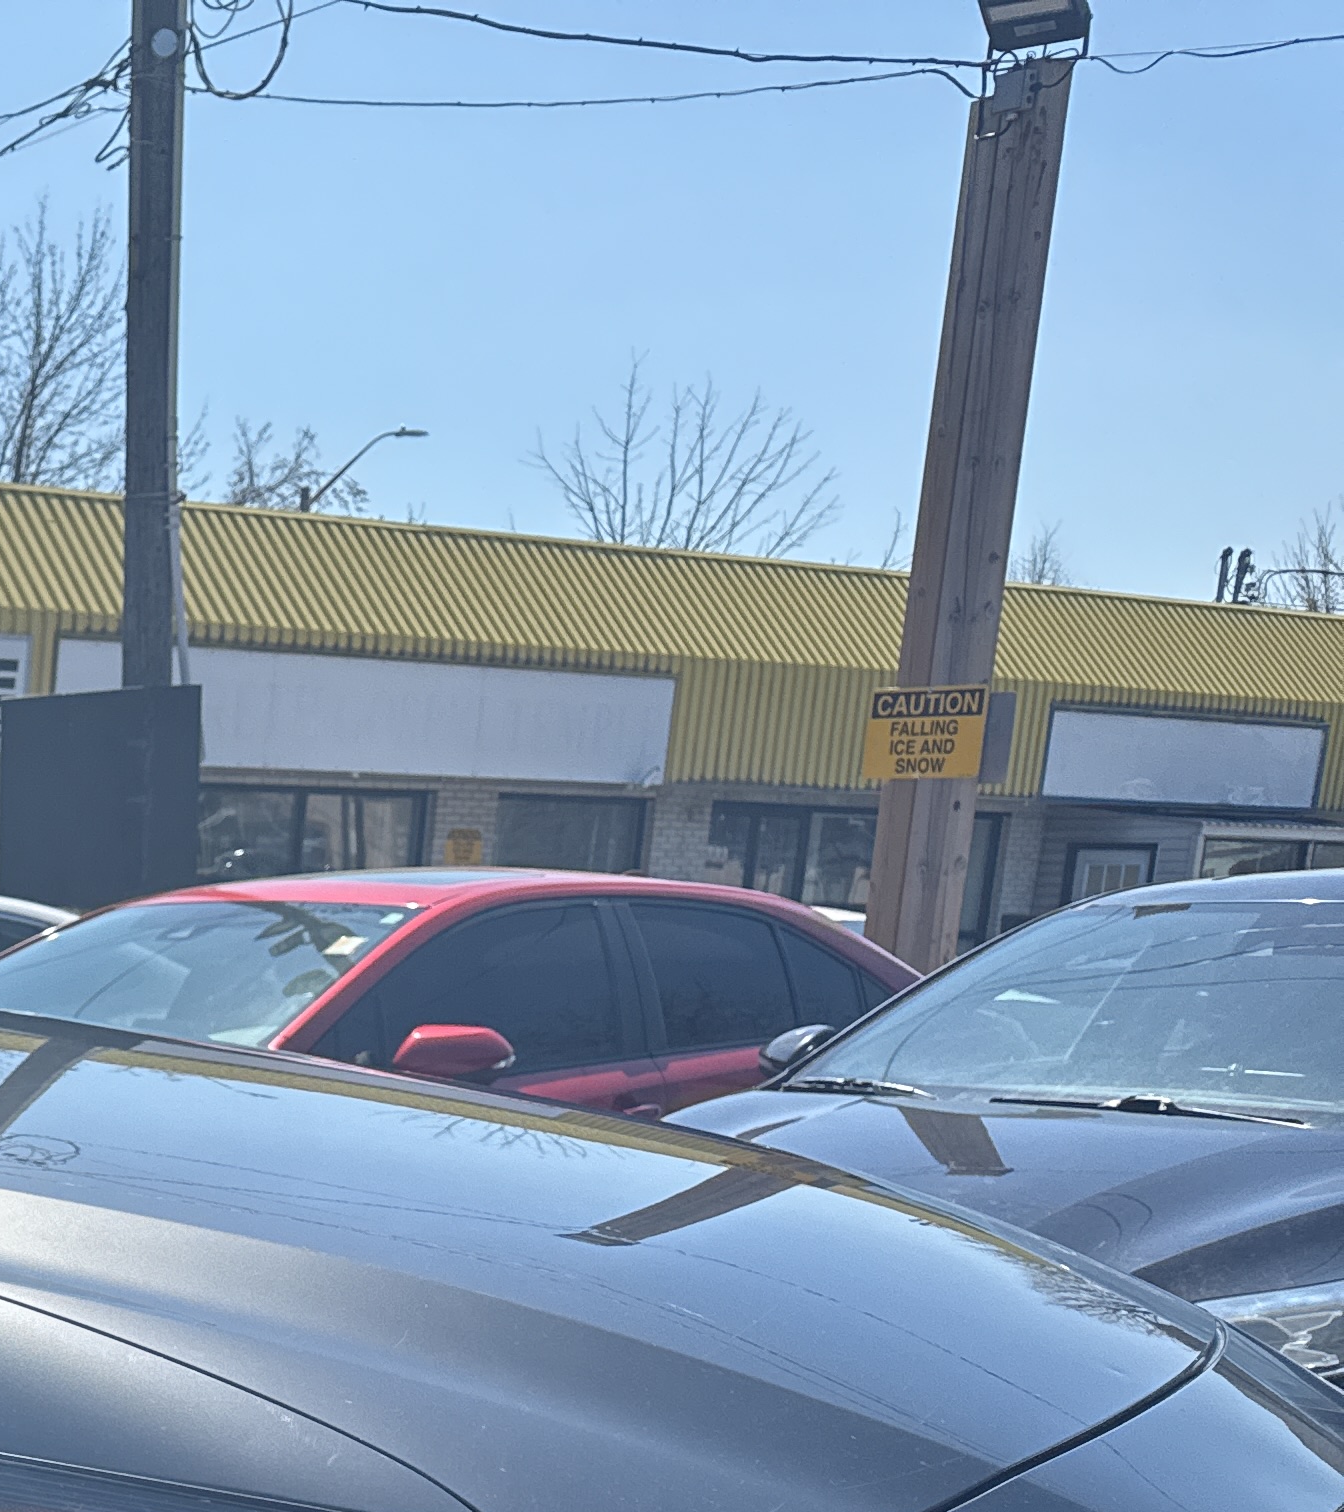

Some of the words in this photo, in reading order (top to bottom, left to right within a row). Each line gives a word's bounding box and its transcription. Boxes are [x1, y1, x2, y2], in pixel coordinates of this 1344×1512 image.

[877, 691, 980, 716] CAUTION
[890, 720, 959, 737] FALLING
[889, 739, 916, 756] ICE
[919, 738, 955, 755] AND
[894, 757, 946, 775] SNOW
